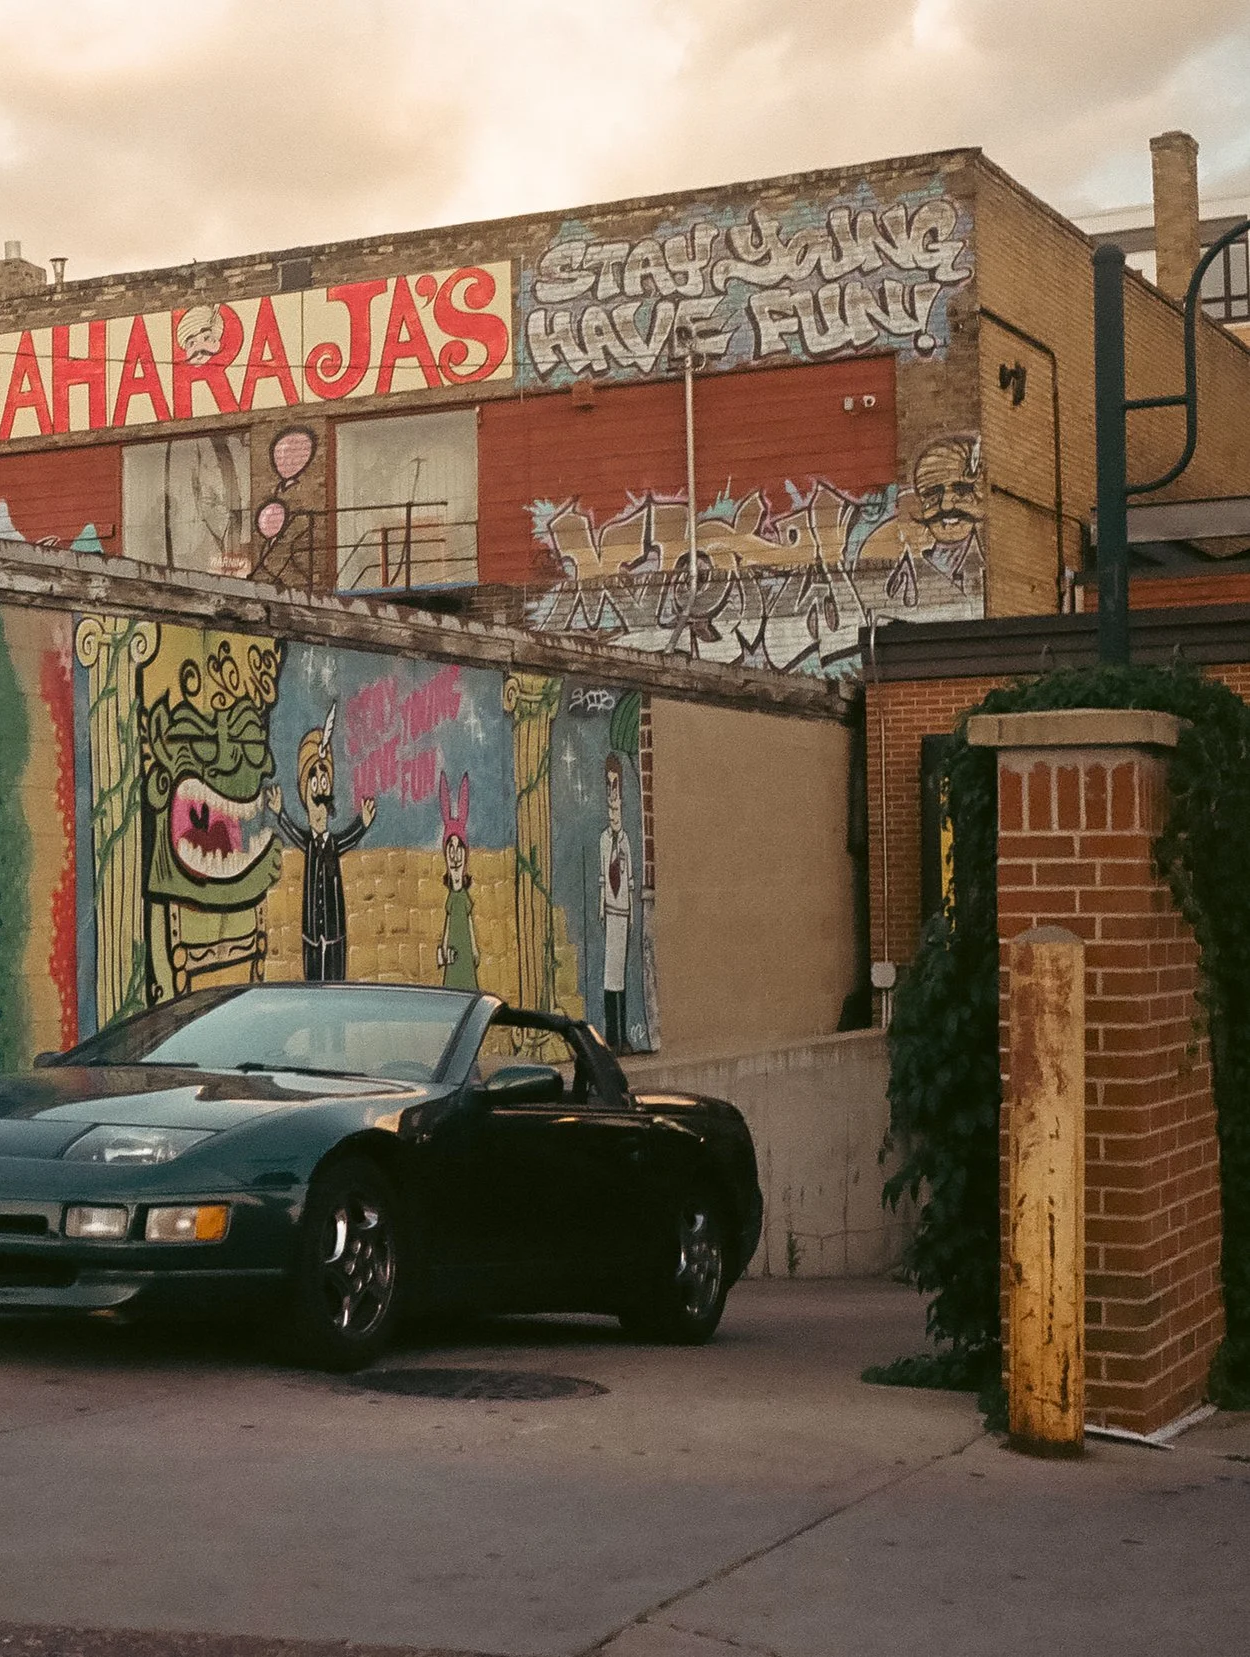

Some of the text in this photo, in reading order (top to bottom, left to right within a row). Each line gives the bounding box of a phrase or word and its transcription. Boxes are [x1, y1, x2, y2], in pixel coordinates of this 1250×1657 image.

[533, 201, 975, 303] STAY YOUNG
[526, 278, 942, 383] HAVE FUN!
